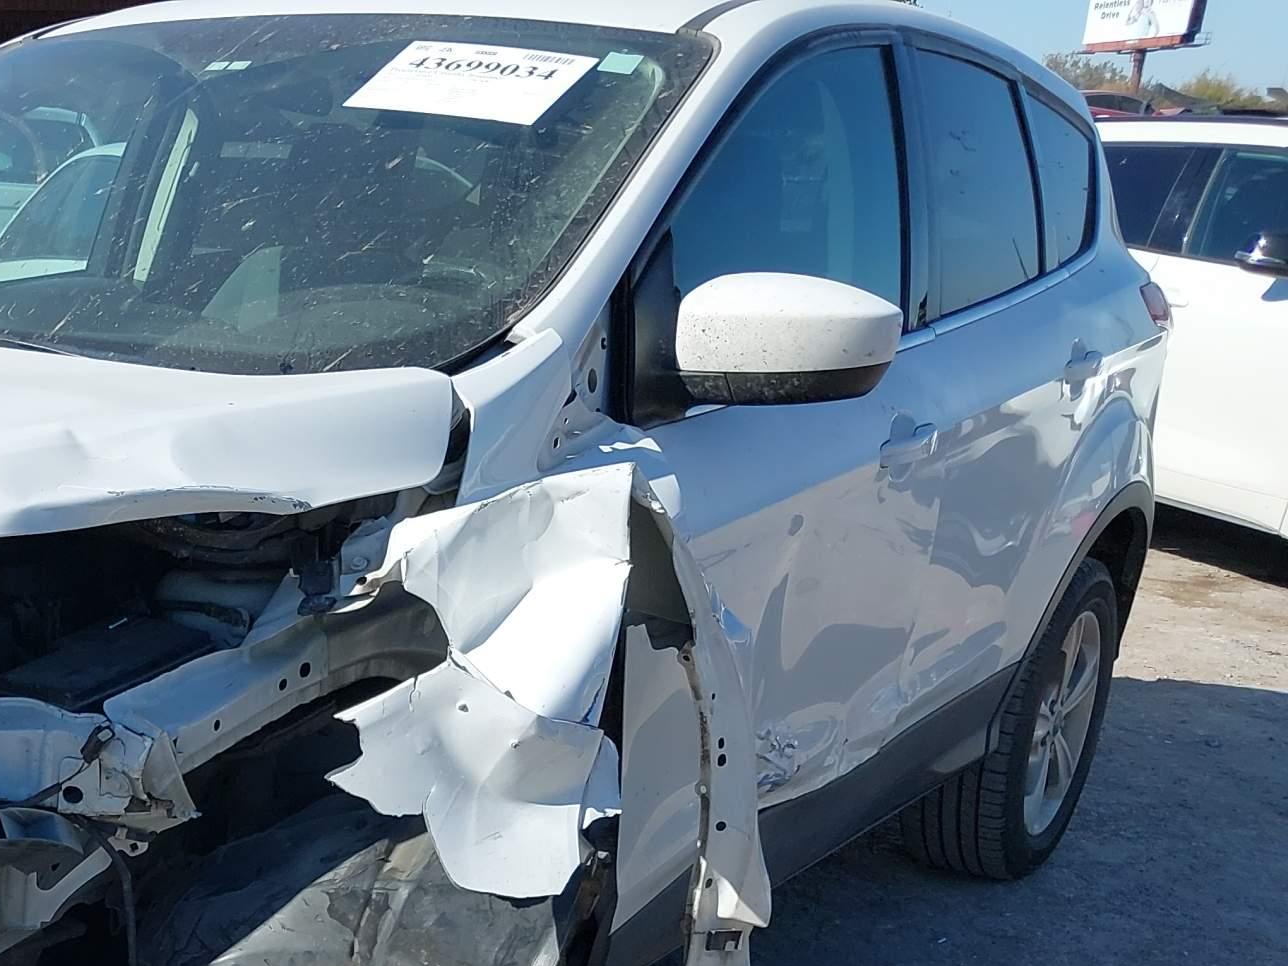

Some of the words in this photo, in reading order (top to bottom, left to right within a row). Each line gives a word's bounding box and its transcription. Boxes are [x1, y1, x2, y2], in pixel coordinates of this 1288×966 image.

[1094, 0, 1130, 9] Relentless
[1100, 11, 1120, 19] Drive
[409, 56, 559, 80] 43699034
